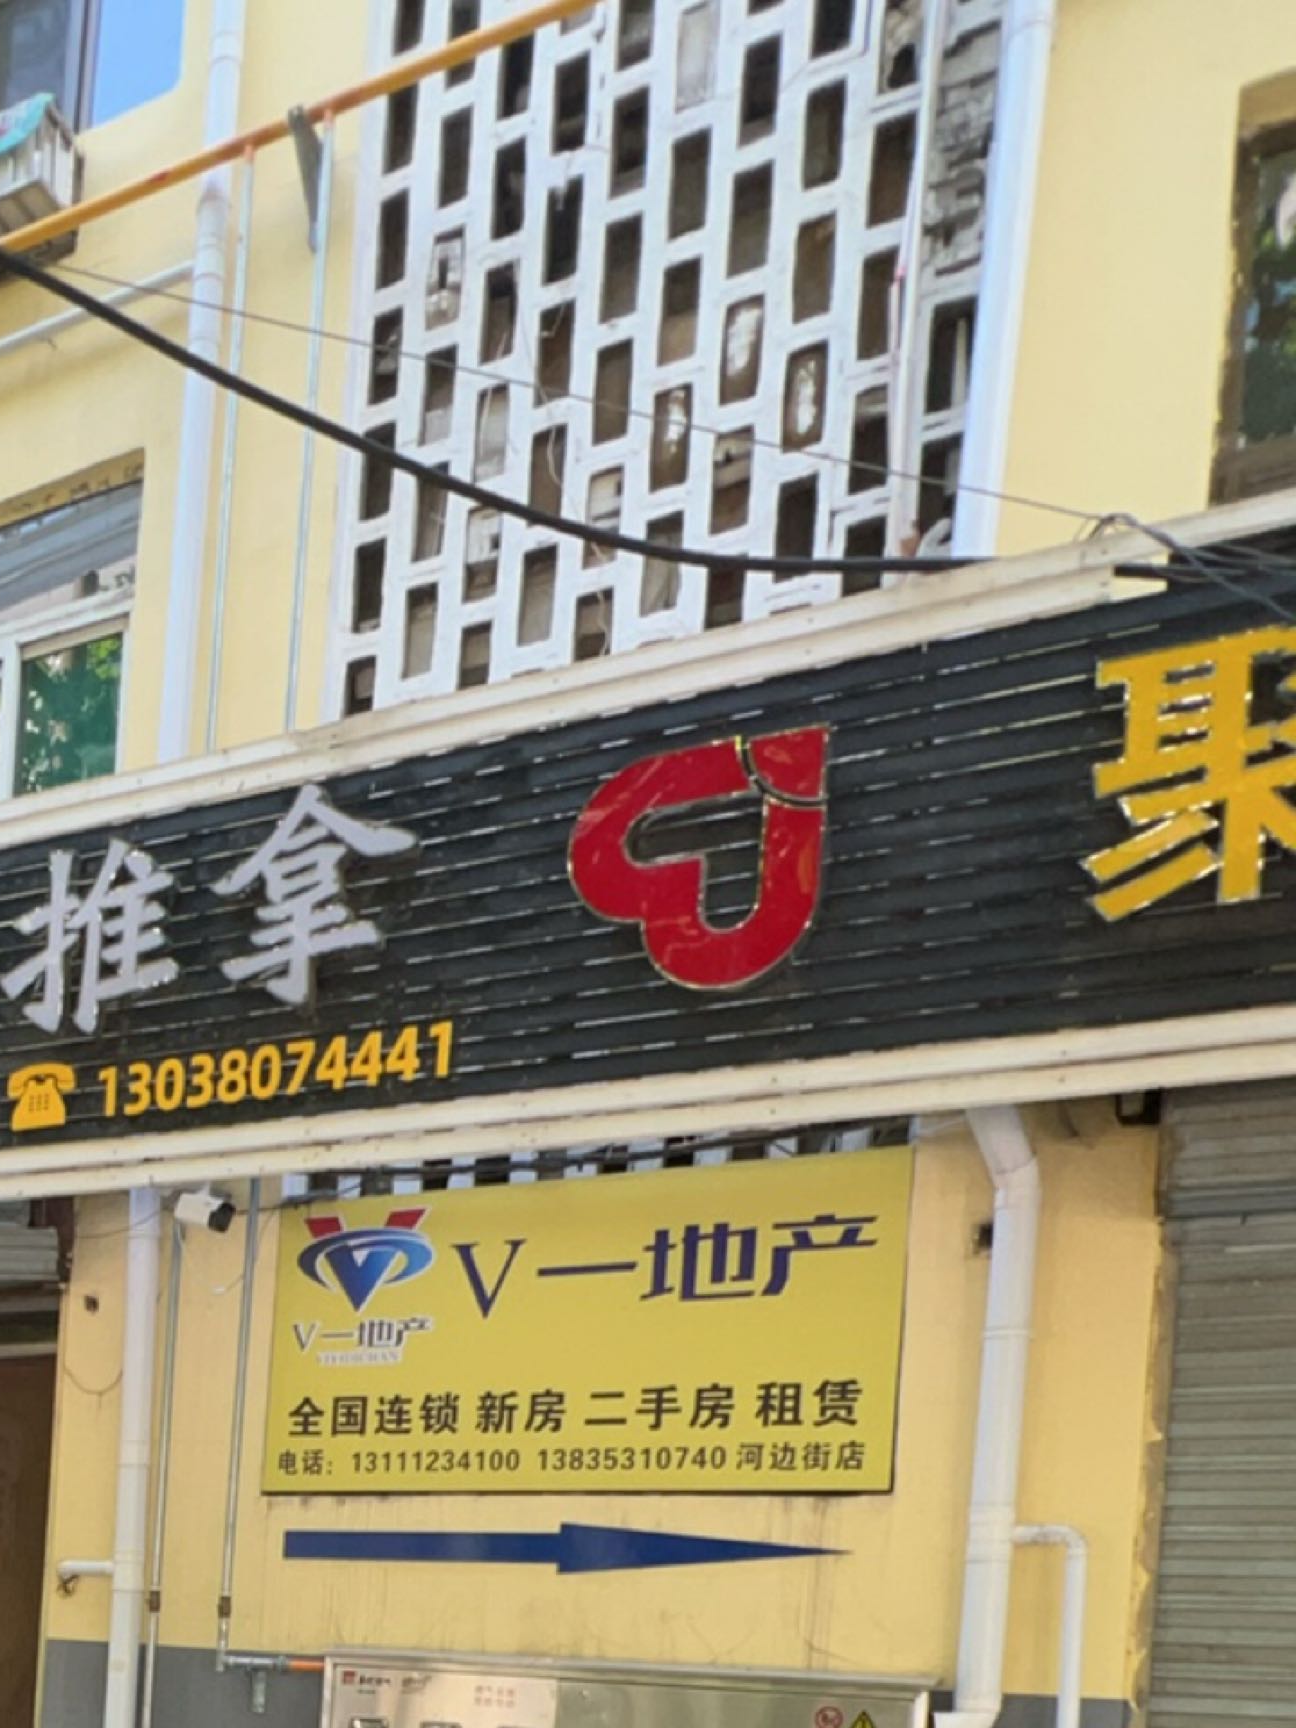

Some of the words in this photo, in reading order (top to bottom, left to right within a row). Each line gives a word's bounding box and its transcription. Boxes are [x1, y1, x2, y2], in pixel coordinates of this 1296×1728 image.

[97, 1020, 454, 1117] 13038074441
[451, 1213, 879, 1319] V一地产
[287, 1391, 460, 1437] 全国连锁
[475, 1388, 566, 1434] 新房
[584, 1382, 735, 1429] 二手房
[755, 1379, 863, 1427] 租赁
[351, 1448, 520, 1474] 13111234100
[537, 1445, 726, 1472] 13835310740
[735, 1442, 865, 1471] 河边街店
